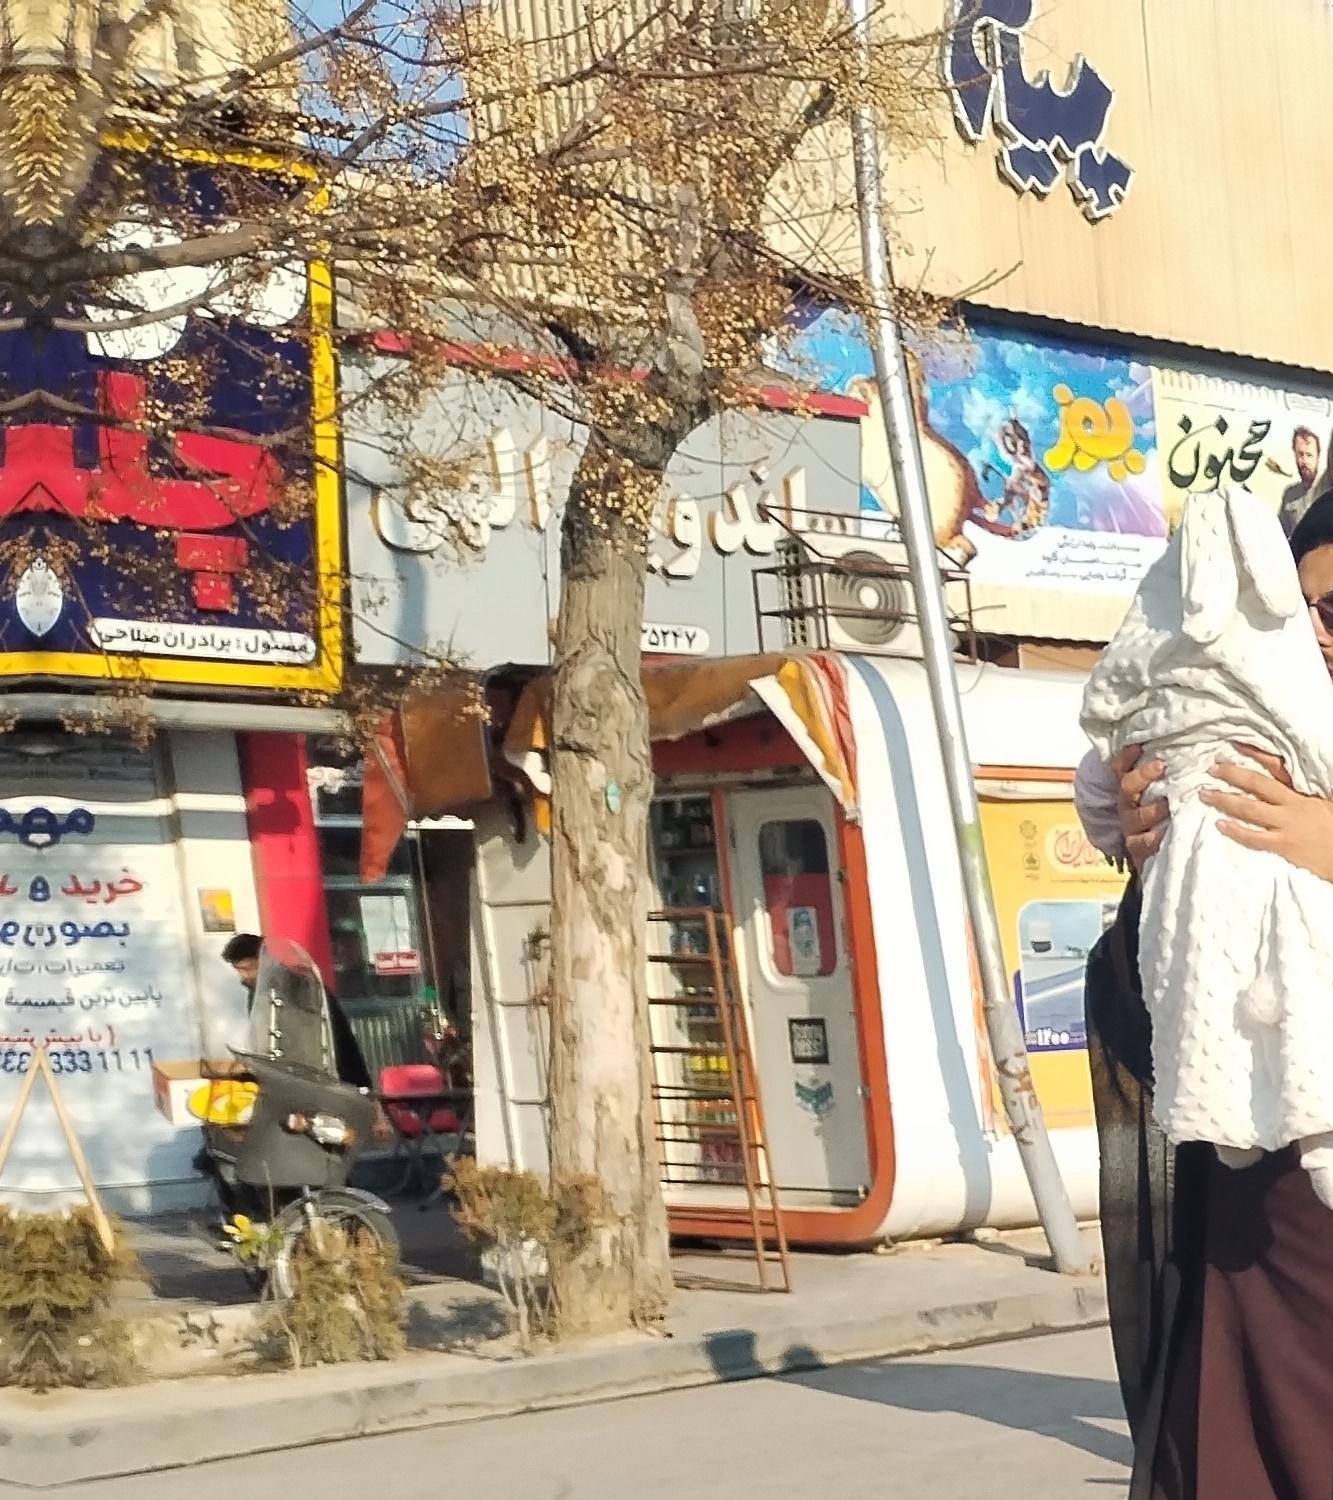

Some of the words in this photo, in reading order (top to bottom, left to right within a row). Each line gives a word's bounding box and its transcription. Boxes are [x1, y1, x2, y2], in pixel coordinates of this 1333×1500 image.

[1168, 413, 1271, 494] مجنون
[163, 631, 232, 652] برادران
[61, 866, 144, 904] خرید
